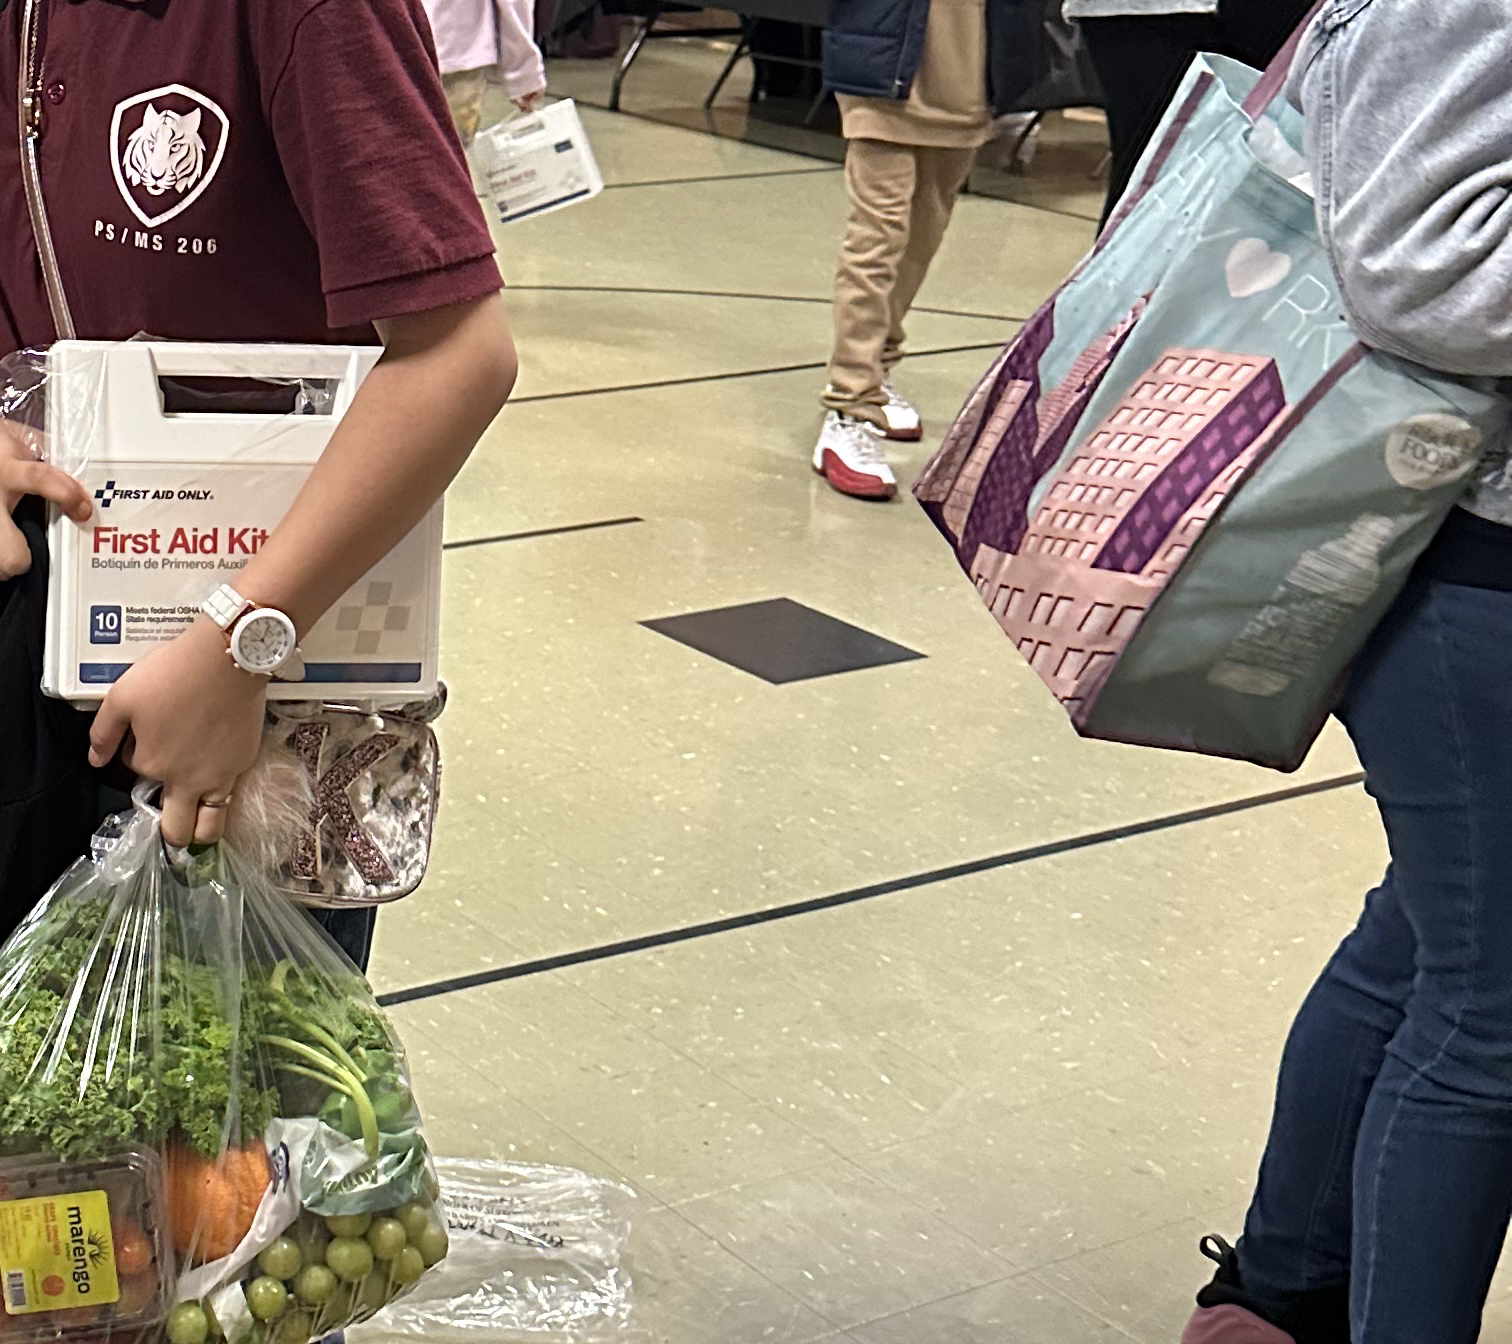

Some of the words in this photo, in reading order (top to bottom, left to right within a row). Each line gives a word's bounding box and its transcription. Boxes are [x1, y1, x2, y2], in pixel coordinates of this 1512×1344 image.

[177, 238, 218, 254] 206
[112, 489, 150, 500] FIRST
[151, 489, 175, 500] AID
[93, 526, 160, 554] First
[167, 527, 218, 554] Aid
[228, 527, 270, 554] Kit
[143, 558, 159, 569] de
[161, 558, 215, 570] Primeros
[95, 612, 118, 630] 10
[67, 1206, 90, 1294] marengo
